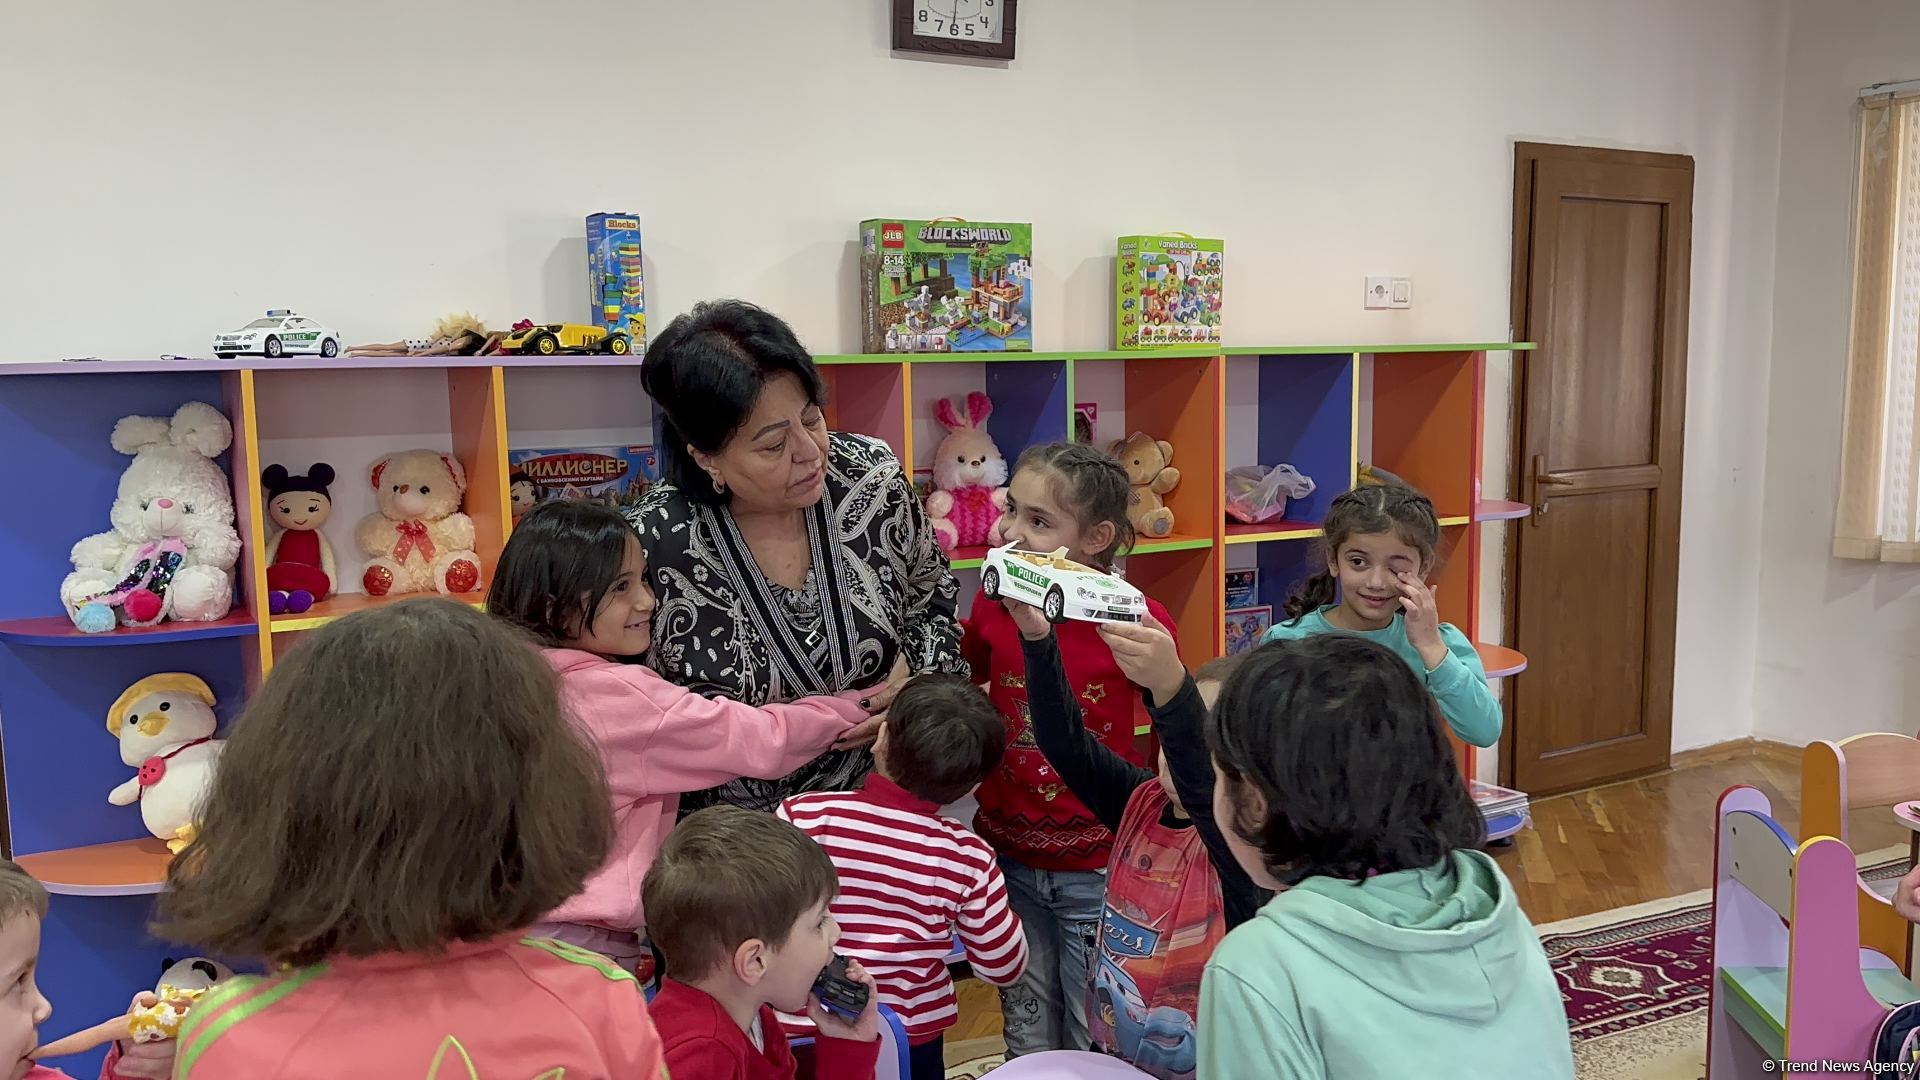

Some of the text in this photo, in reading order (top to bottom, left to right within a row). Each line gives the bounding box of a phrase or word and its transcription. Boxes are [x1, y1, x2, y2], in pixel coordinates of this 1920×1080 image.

[918, 10, 928, 22] 8
[980, 16, 989, 28] 4
[934, 20, 944, 32] 7
[949, 23, 959, 36] 6
[965, 24, 975, 36] 5
[608, 220, 636, 228] Blocks
[918, 226, 1012, 242] BLOCKSWORLD
[884, 255, 904, 265] 8-14
[1018, 567, 1046, 586] POLICE
